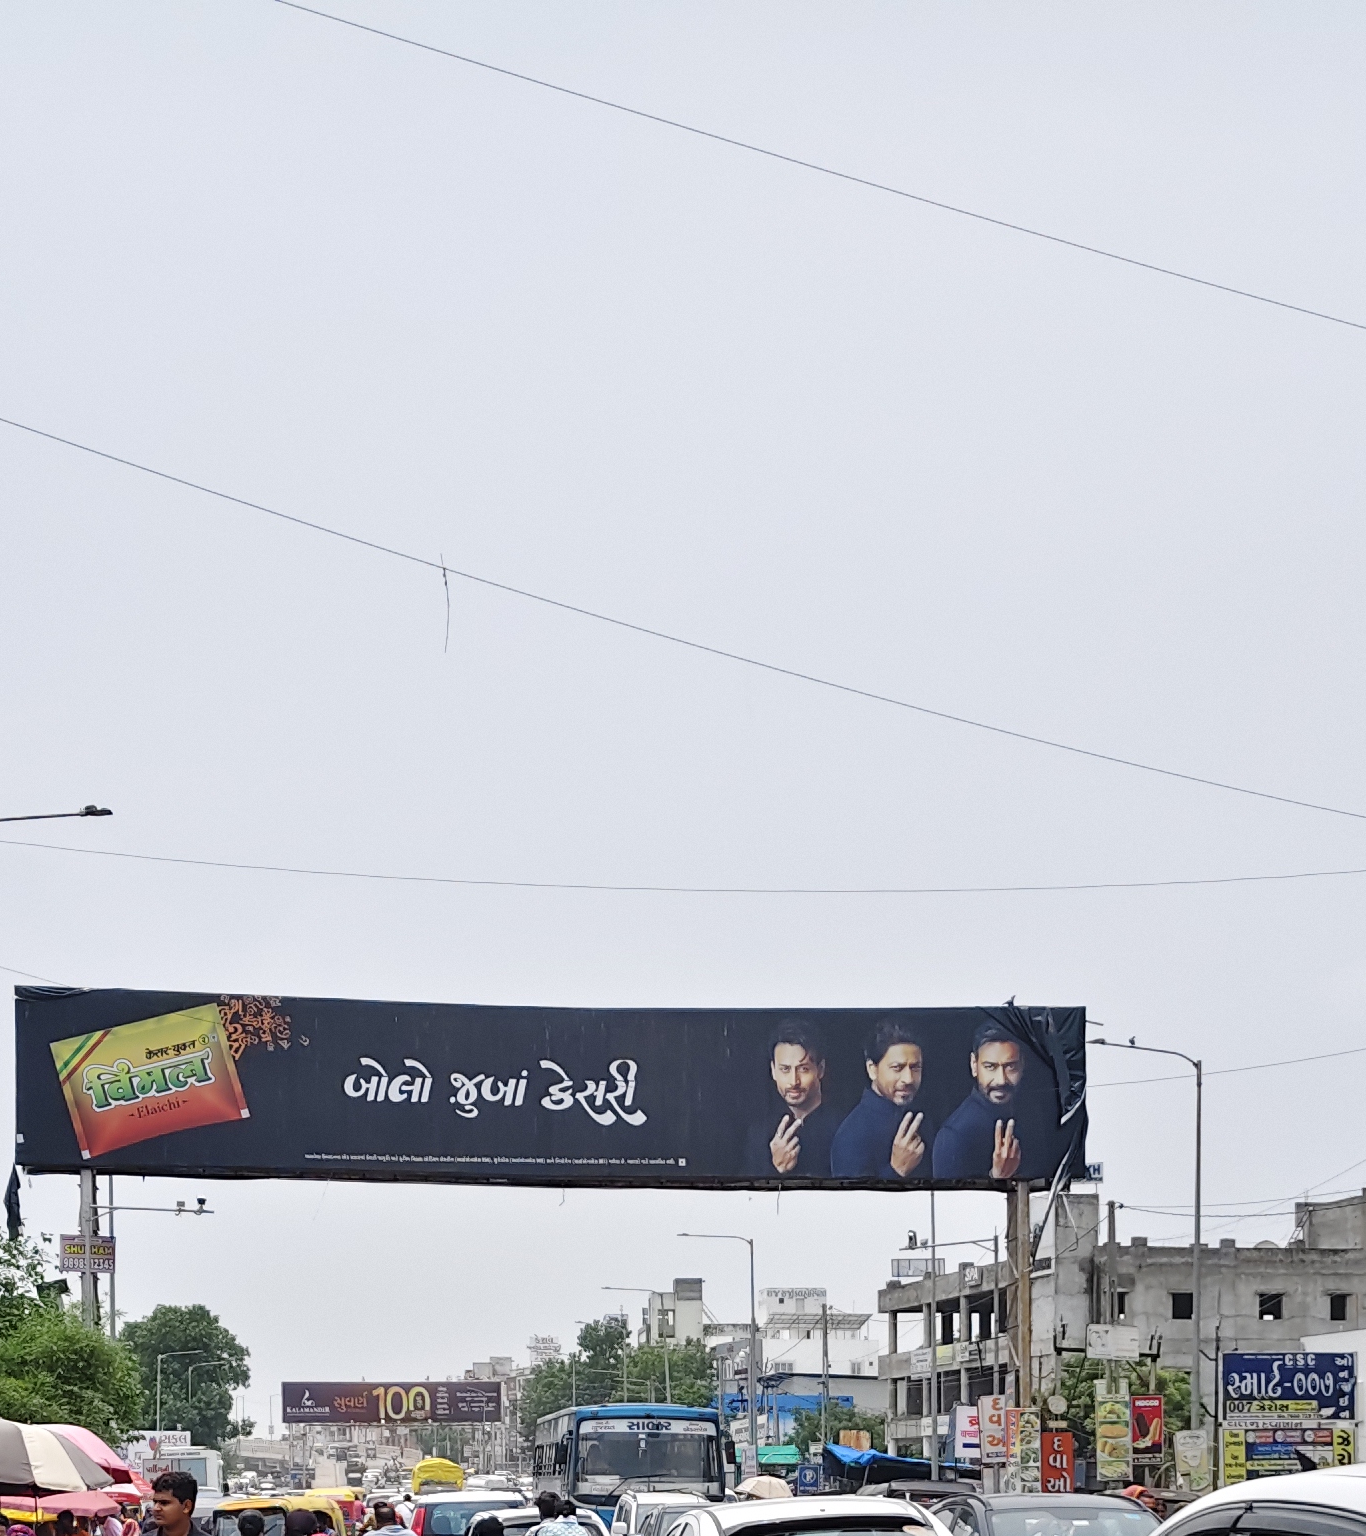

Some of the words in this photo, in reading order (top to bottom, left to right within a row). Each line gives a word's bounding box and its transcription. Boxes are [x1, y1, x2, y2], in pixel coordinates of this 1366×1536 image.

[83, 1048, 215, 1112] विमल
[343, 1057, 433, 1104] બોલો
[539, 1059, 648, 1126] કેસરી
[63, 1243, 114, 1256] SHUHAM
[964, 1266, 979, 1281] SPA
[1226, 1360, 1334, 1400] સ્માર્ટ-૦૦૭
[333, 1391, 368, 1413] સુવર્ણ
[372, 1385, 432, 1420] 100
[1228, 1401, 1253, 1413] 007
